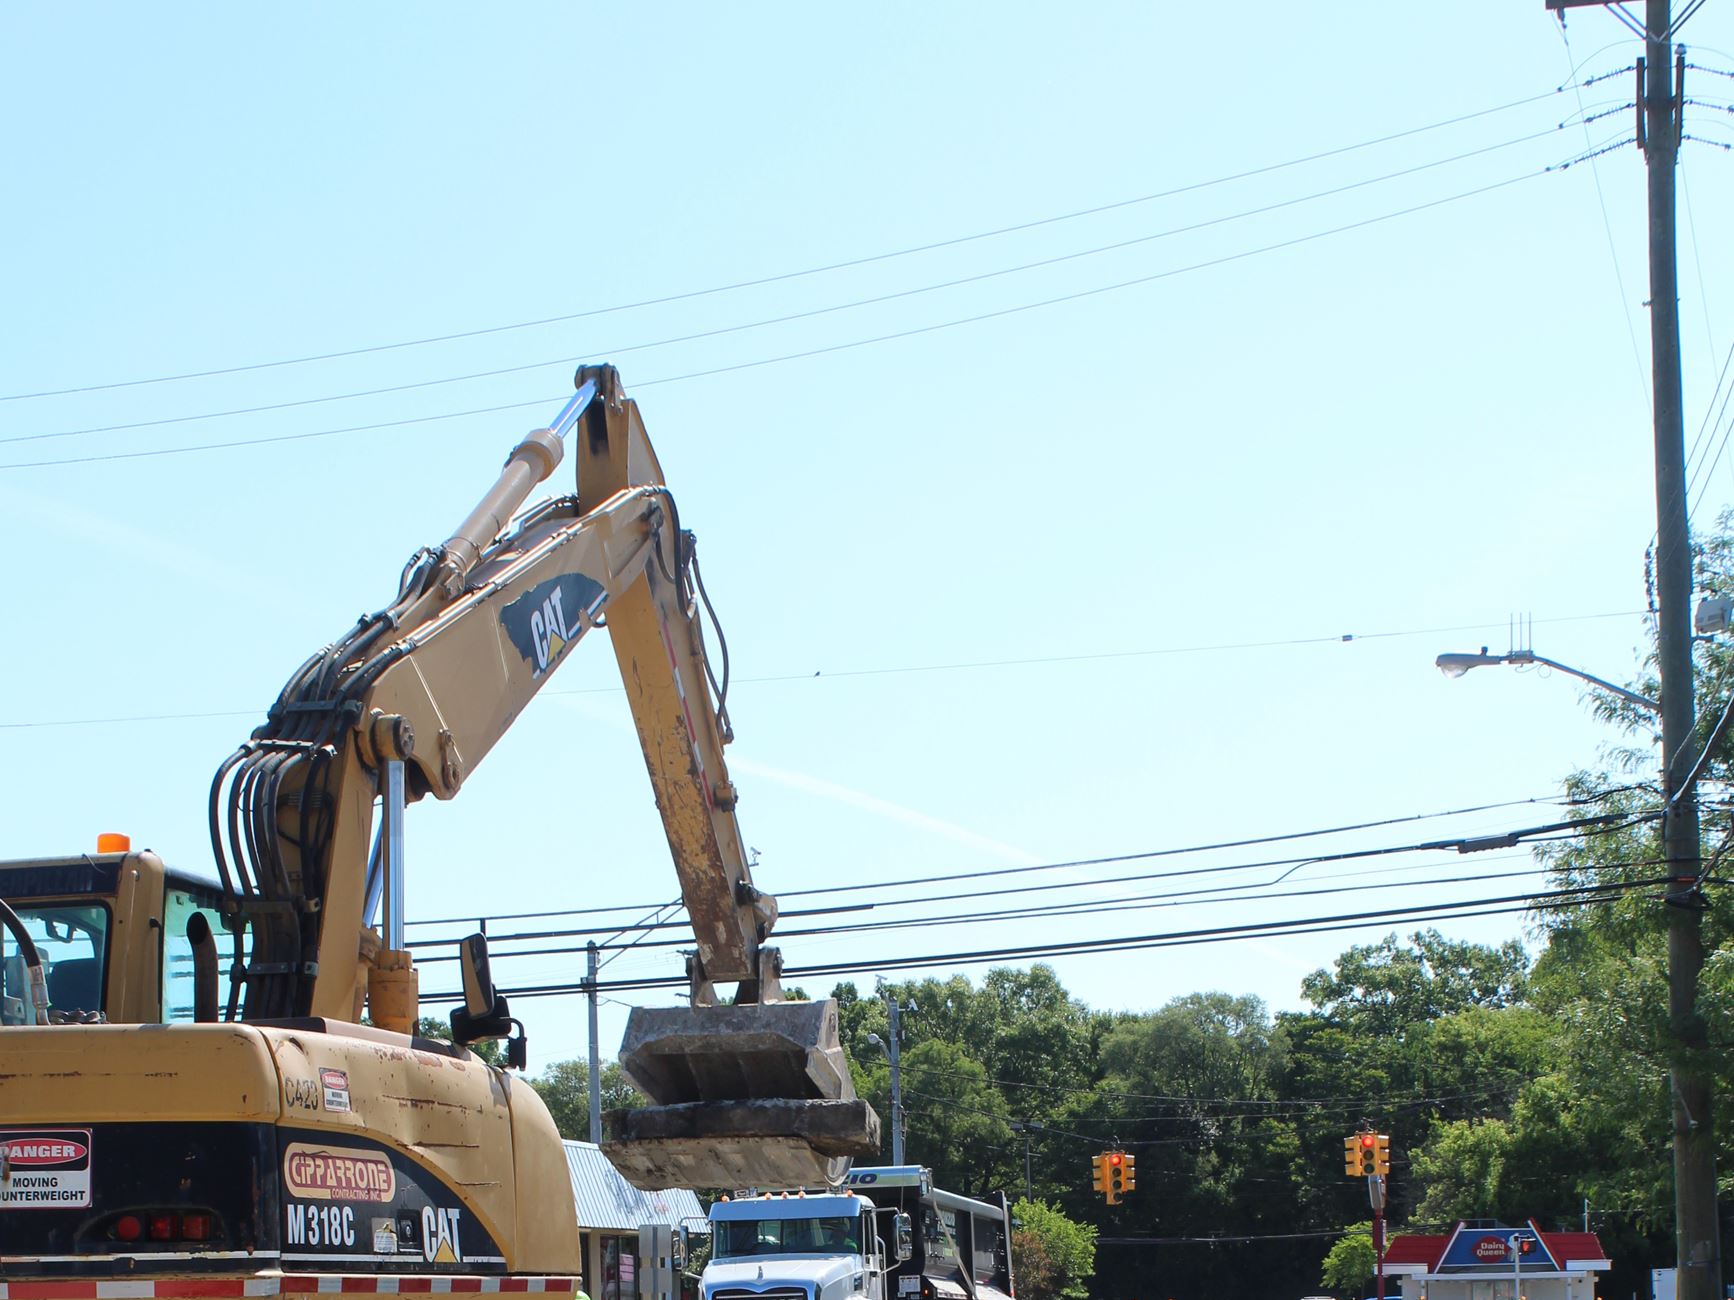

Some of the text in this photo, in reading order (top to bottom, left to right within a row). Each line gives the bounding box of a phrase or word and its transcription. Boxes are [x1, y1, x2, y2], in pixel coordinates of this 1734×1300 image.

[531, 585, 569, 670] CAT
[12, 1177, 58, 1188] MOVING
[0, 1190, 86, 1201] UNTERWEIGHT
[331, 1188, 369, 1199] CONTRACTING
[422, 1205, 461, 1263] CAT
[1481, 1242, 1505, 1250] Dairy
[1476, 1249, 1505, 1257] Queen
